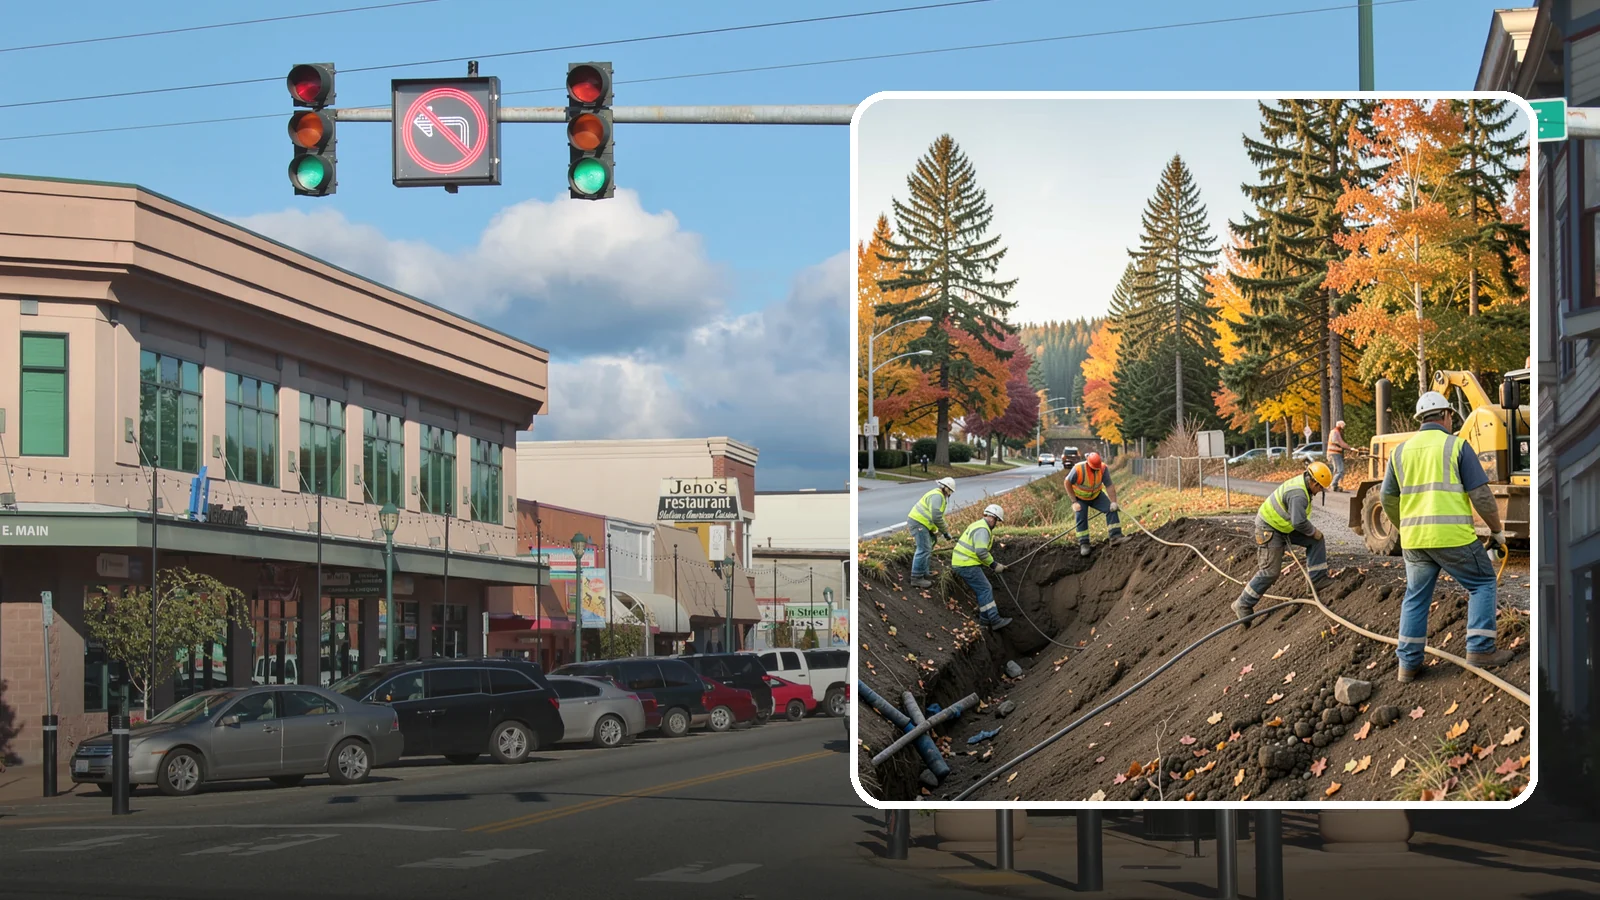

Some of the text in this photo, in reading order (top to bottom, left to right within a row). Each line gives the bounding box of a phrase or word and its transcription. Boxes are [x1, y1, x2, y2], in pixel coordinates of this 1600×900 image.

[670, 480, 727, 494] Jeno's
[665, 496, 731, 509] restaurant
[658, 509, 681, 519] Italian
[686, 509, 714, 519] American
[715, 509, 738, 519] Cuisine
[2, 525, 49, 536] E. MAIN
[797, 607, 829, 616] Street
[788, 619, 824, 627] lass
